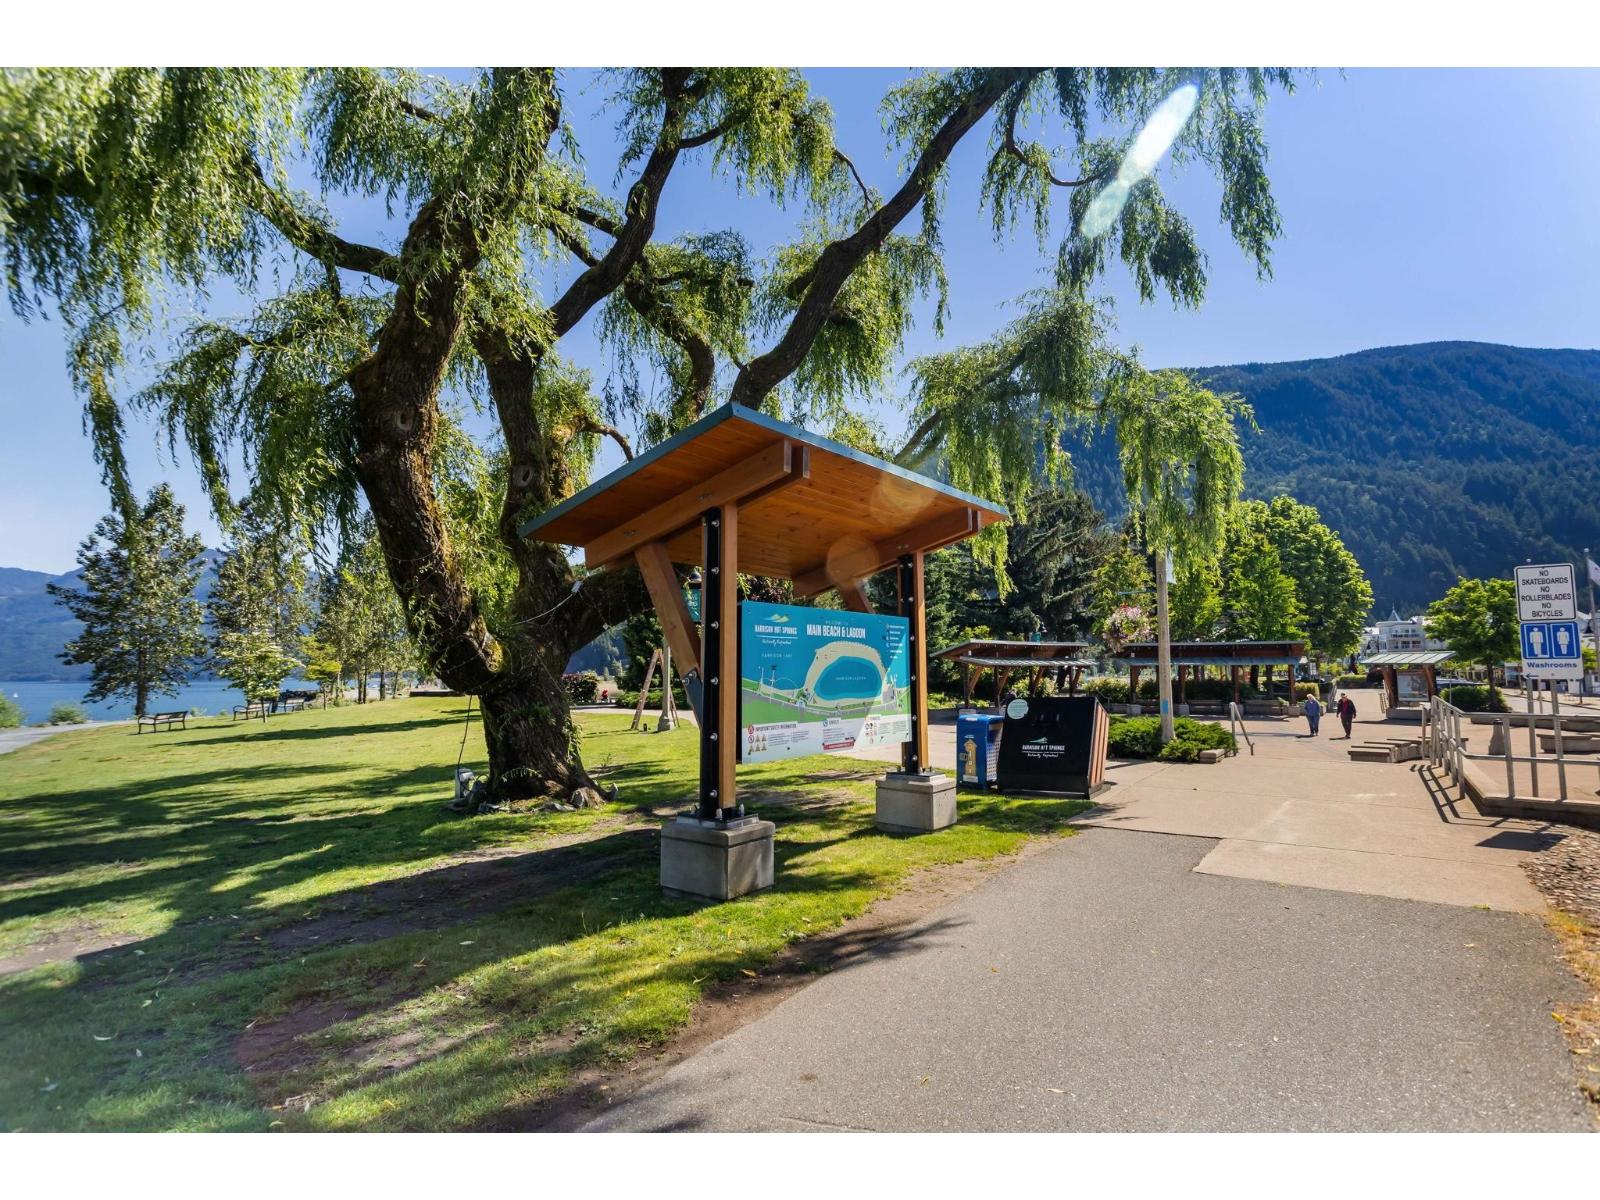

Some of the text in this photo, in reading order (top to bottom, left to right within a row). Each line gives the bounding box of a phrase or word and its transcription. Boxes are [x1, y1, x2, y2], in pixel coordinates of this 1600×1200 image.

[1521, 577, 1569, 586] SKATEBOARDS
[1521, 593, 1572, 602] ROLLERBLADES
[1531, 610, 1564, 618] BICYCLES
[806, 624, 866, 639] MAIN BEACH & LAGOON
